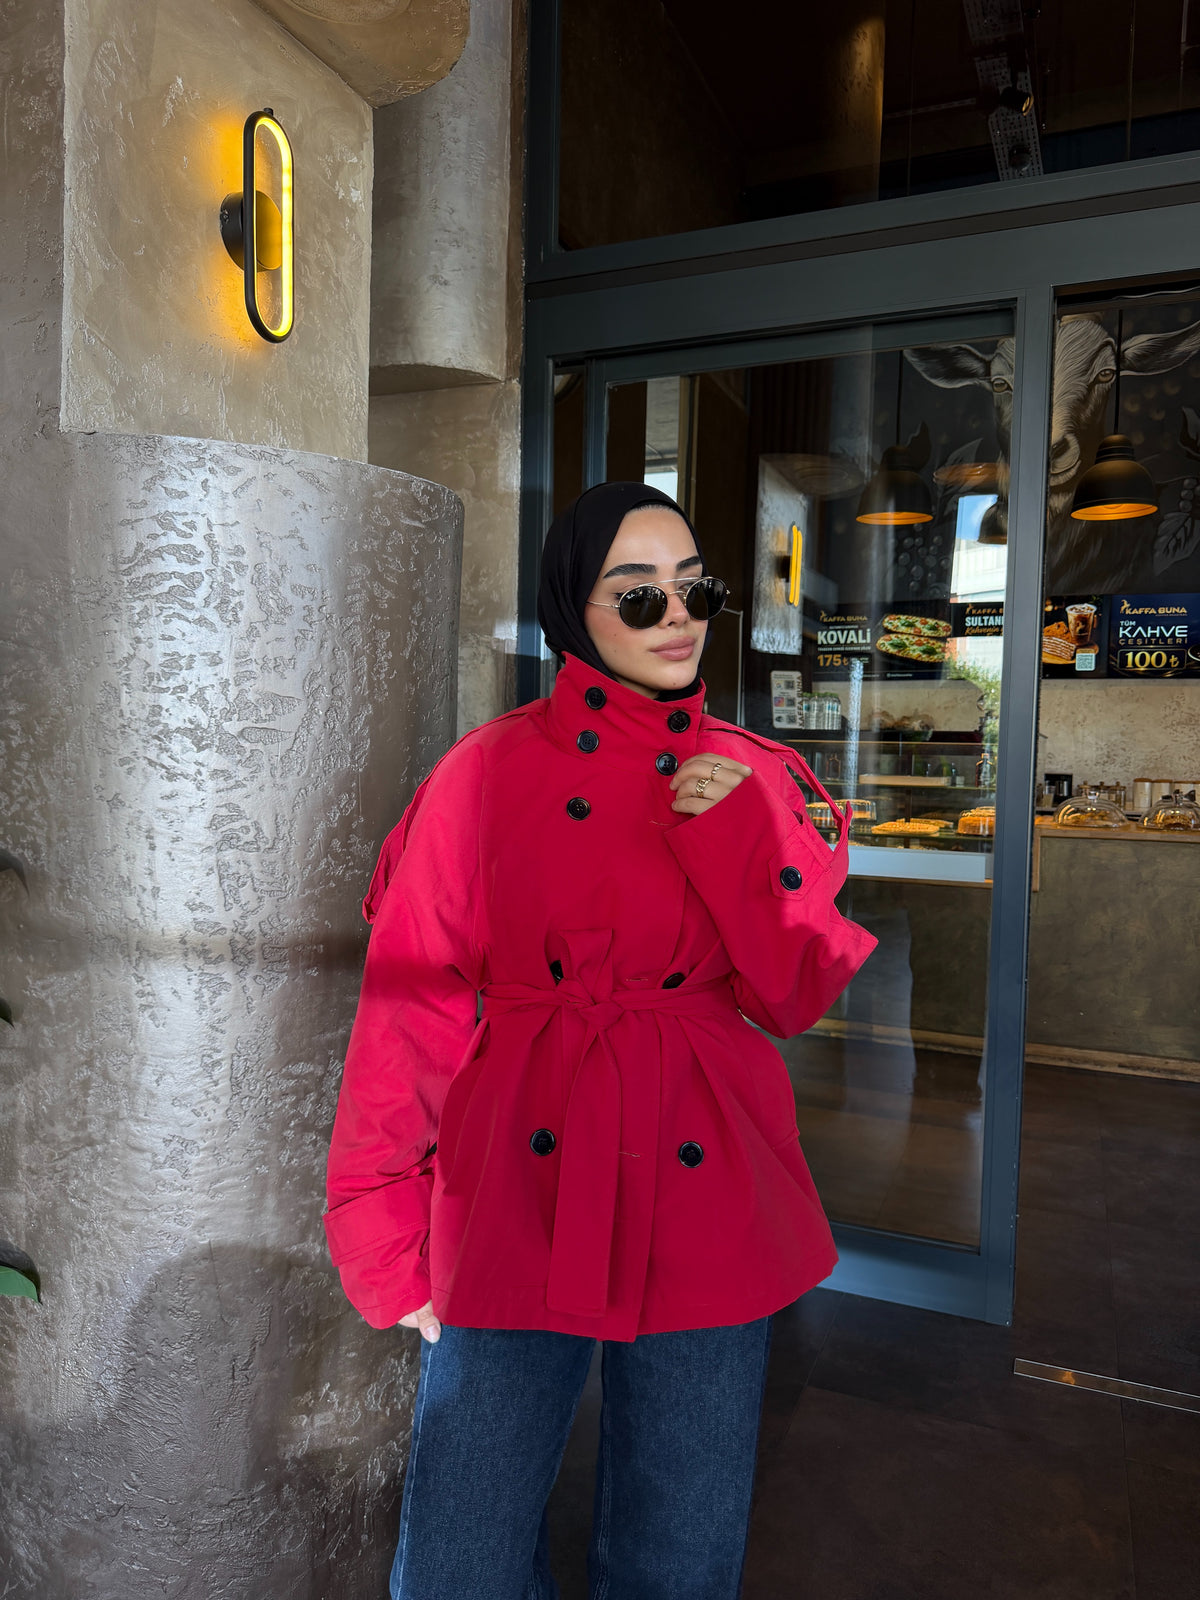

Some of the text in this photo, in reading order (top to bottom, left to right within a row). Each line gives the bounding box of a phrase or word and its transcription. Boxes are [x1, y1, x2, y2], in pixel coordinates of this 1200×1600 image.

[1125, 607, 1157, 615] KAFFA
[1157, 606, 1188, 614] BUNA
[817, 628, 871, 645] KOVALİ
[1119, 625, 1188, 638] KAHVE
[1118, 637, 1188, 646] ÇEŞİTLERİ
